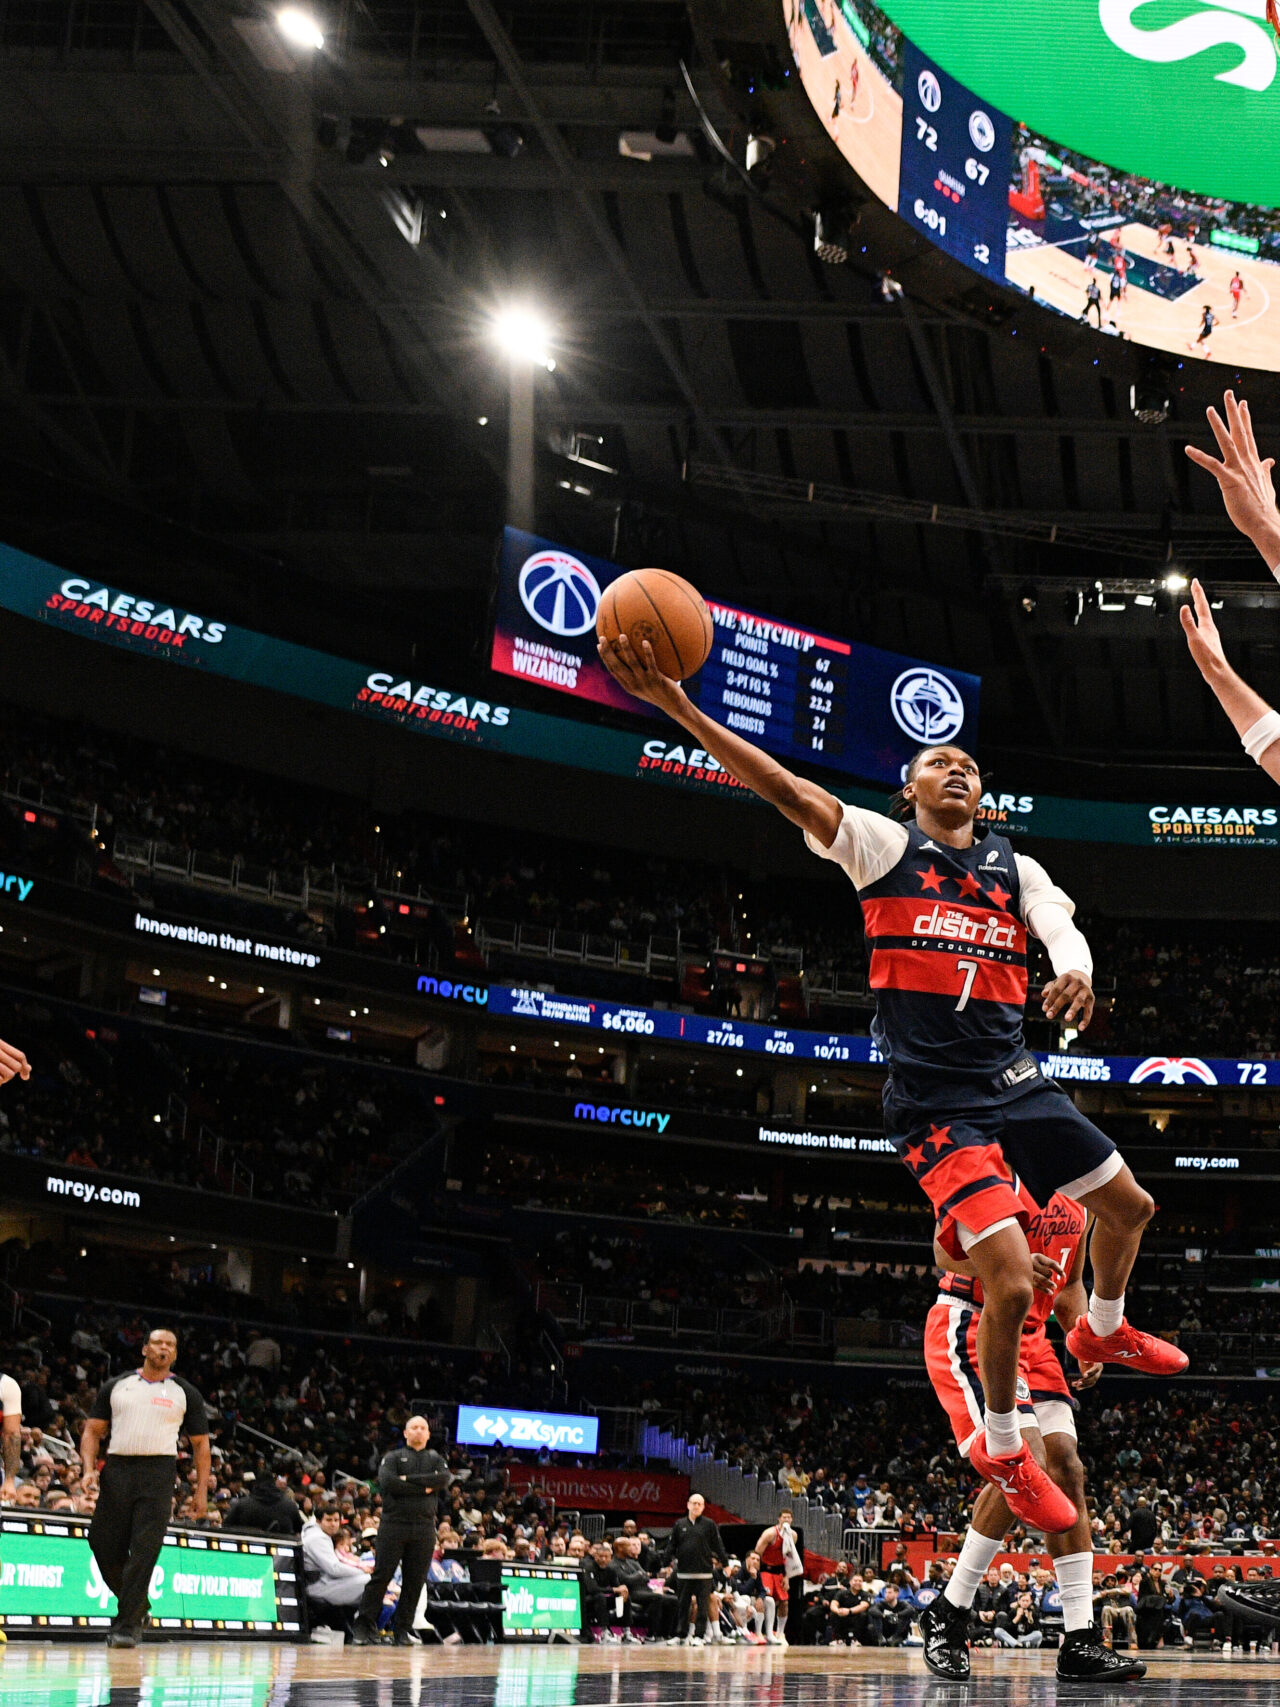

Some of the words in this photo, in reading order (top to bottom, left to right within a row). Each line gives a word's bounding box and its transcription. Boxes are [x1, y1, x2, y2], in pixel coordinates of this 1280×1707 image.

[916, 116, 937, 152] 72
[964, 157, 990, 186] 67
[914, 198, 946, 236] 6:01
[46, 594, 189, 648] SPORTSBOOK
[60, 578, 227, 643] CAESARS
[735, 632, 768, 655] POINTS
[738, 615, 815, 652] MATCHUP
[512, 649, 577, 689] WIZARDS
[721, 648, 746, 668] FIELD
[745, 655, 769, 676] GOAL
[770, 662, 779, 678] %
[367, 673, 510, 726] CAESARS
[762, 680, 771, 696] %
[357, 687, 479, 732] SPORTSBOOK
[722, 689, 772, 717] REBOUNDS
[809, 695, 832, 713] 22.2
[727, 712, 765, 735] ASSISTS
[643, 740, 726, 773] CAES
[1149, 806, 1278, 825] CAESARS
[1152, 823, 1255, 836] SPORTSBOOK
[913, 904, 1017, 948] district
[946, 910, 964, 919] THE
[135, 913, 218, 947] Innovation
[219, 933, 252, 955] that
[417, 975, 488, 1005] mercu
[954, 959, 978, 1012] 7
[602, 1012, 655, 1034] $6,060
[707, 1030, 744, 1048] 27/56
[765, 1039, 794, 1055] 8/20
[1040, 1061, 1111, 1081] WIZARDS
[1048, 1055, 1104, 1067] WASHINGTON
[1237, 1063, 1266, 1085] 72
[574, 1102, 670, 1133] mercury
[759, 1127, 828, 1147] Innovation
[829, 1134, 857, 1149] that
[1174, 1156, 1239, 1170] mrcy.com
[47, 1176, 140, 1207] mrcy.com
[1043, 1204, 1067, 1218] Los
[1024, 1214, 1081, 1246] Angeles
[510, 1417, 584, 1447] ZKsync
[532, 1474, 620, 1500] Hennessy
[619, 1481, 661, 1502] Lofts
[17, 1564, 64, 1588] THIRST
[173, 1572, 201, 1594] OBEY
[201, 1573, 229, 1596] YOUR
[229, 1576, 263, 1598] THIRST
